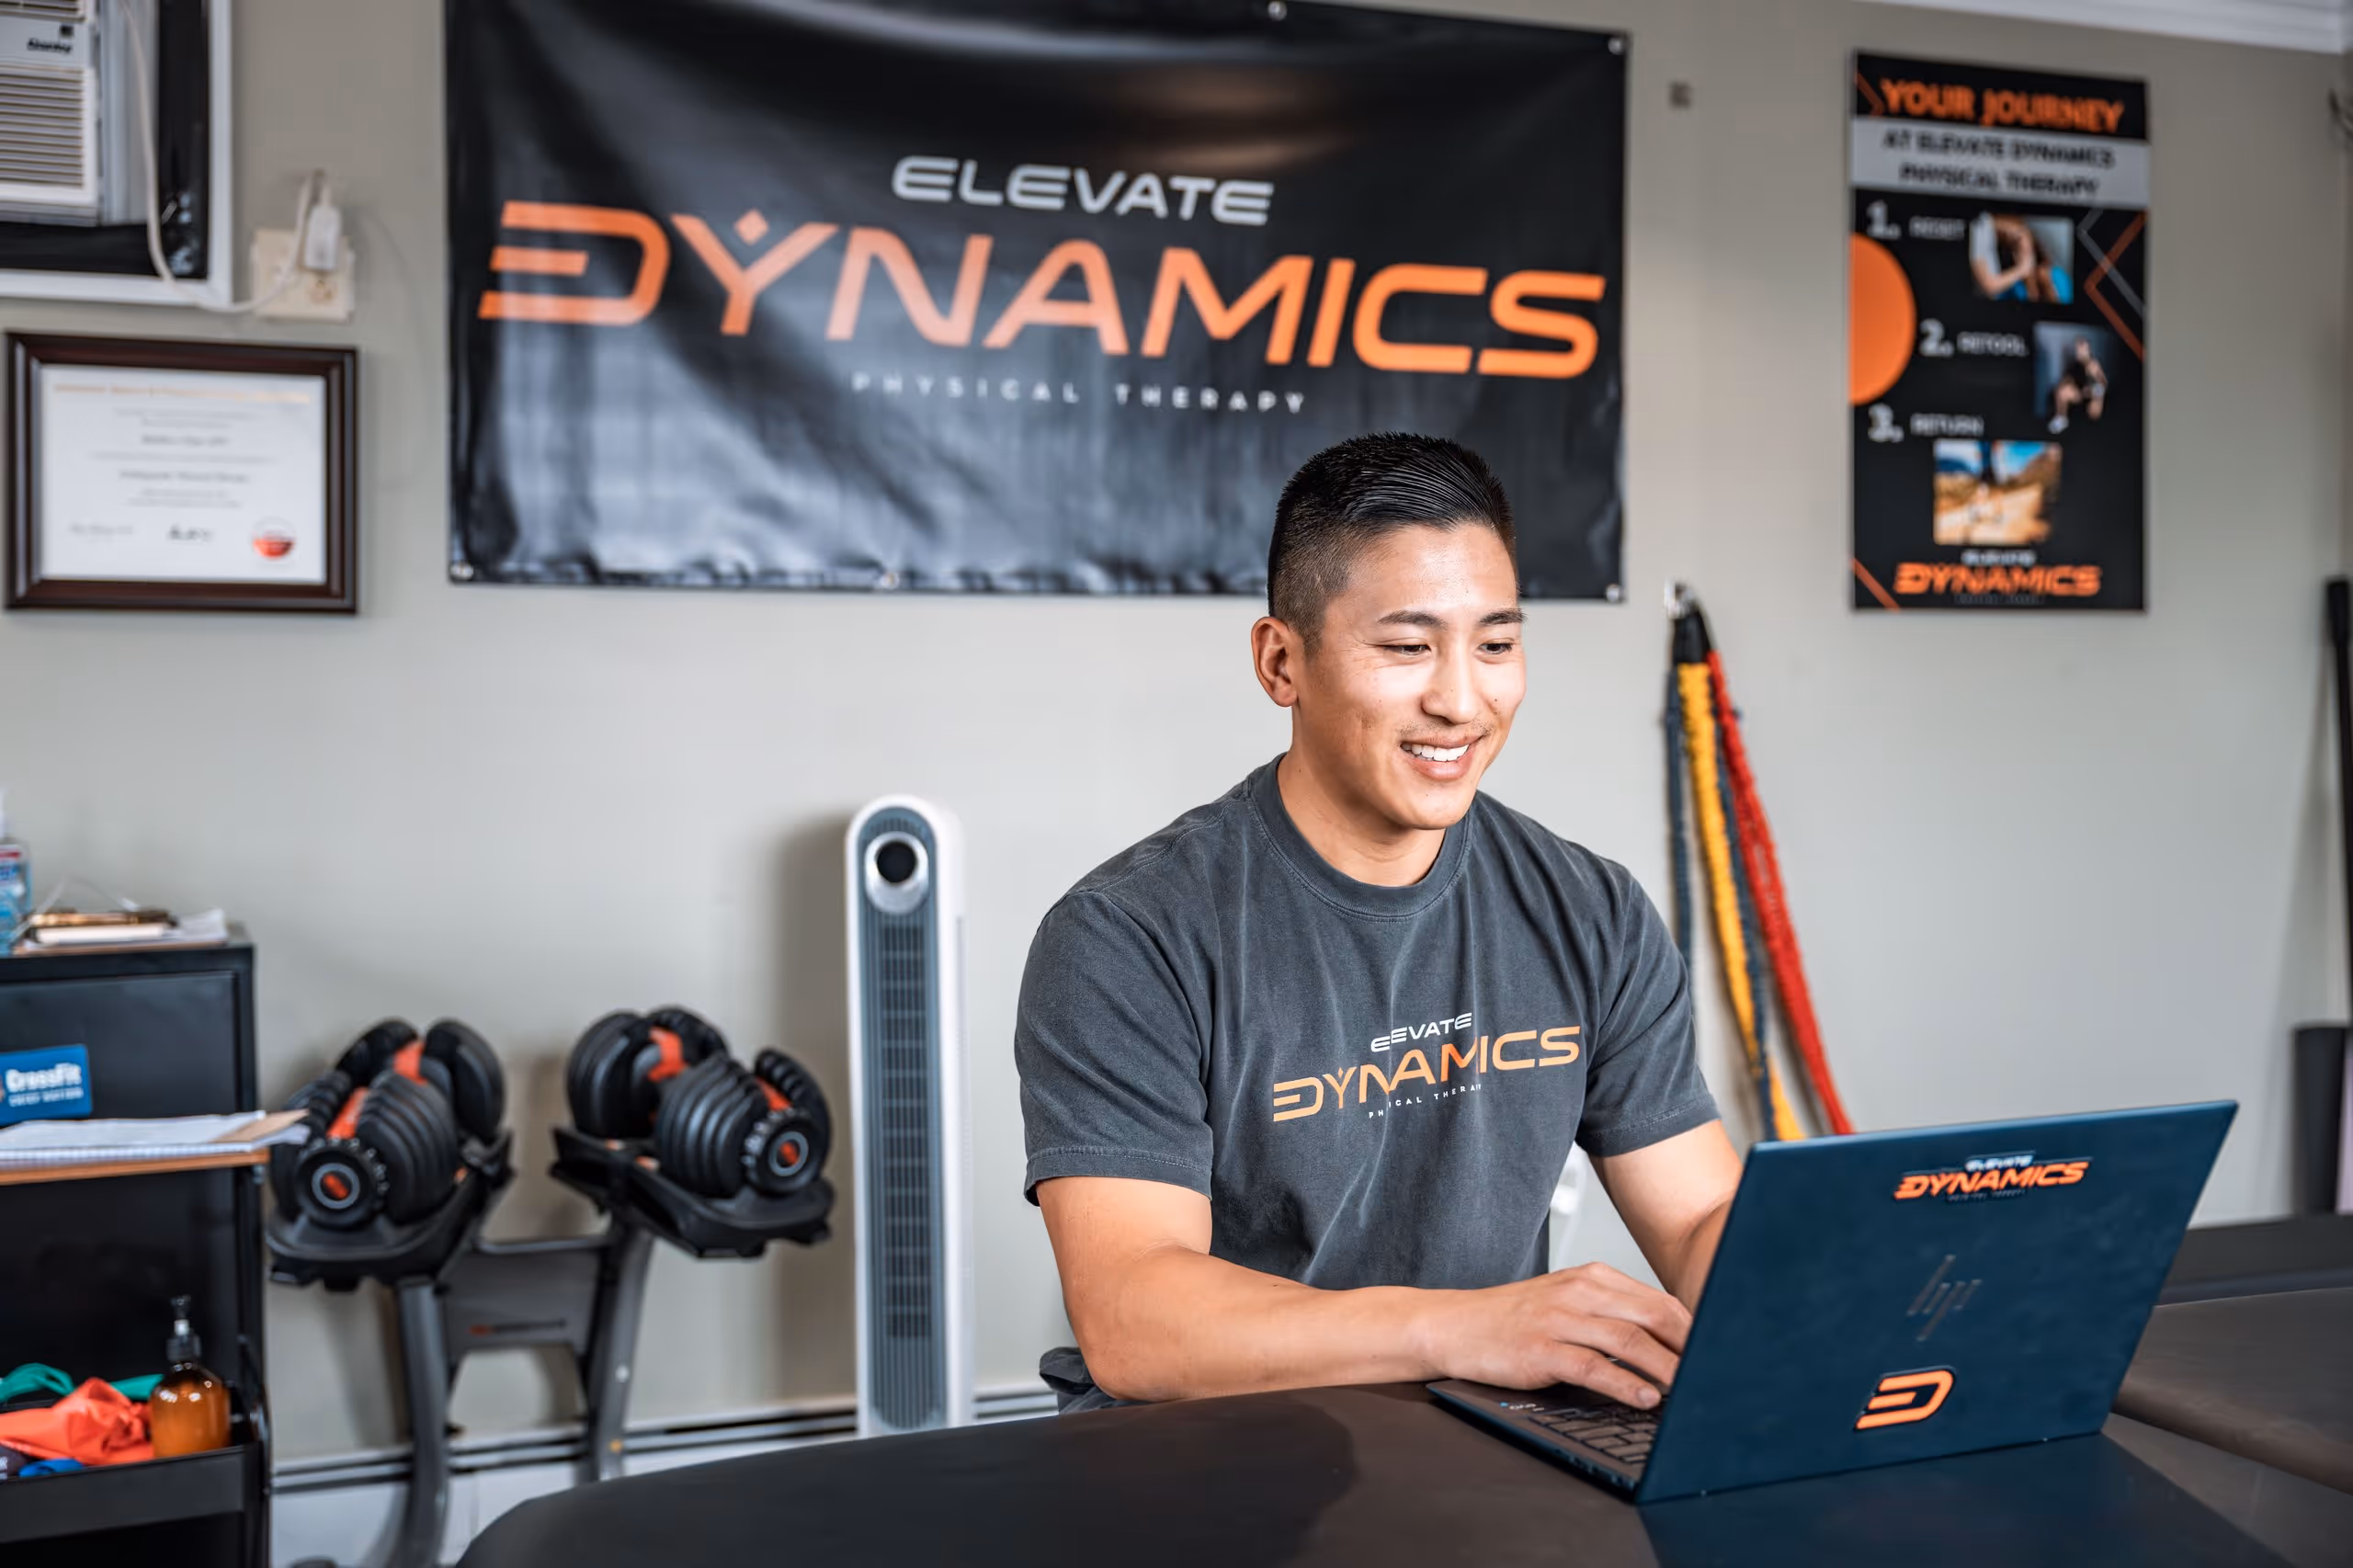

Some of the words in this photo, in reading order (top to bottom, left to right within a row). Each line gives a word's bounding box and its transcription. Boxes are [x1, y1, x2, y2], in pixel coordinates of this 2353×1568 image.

[1880, 78, 1975, 120] YOUR
[1980, 88, 2124, 133] JOURNEY
[891, 155, 1274, 226] ELEVATE
[477, 199, 1607, 379] DYNAMICS
[851, 372, 1080, 404] PHYSICAL
[1115, 381, 1305, 415] THERAPY
[1893, 562, 2102, 597] DYNAMICS
[1370, 1012, 1472, 1052] EEVATE
[1273, 1026, 1581, 1122] DYNAMICS
[1369, 1096, 1423, 1119] PHICAL
[1893, 1162, 2089, 1200] DYNAMICS
